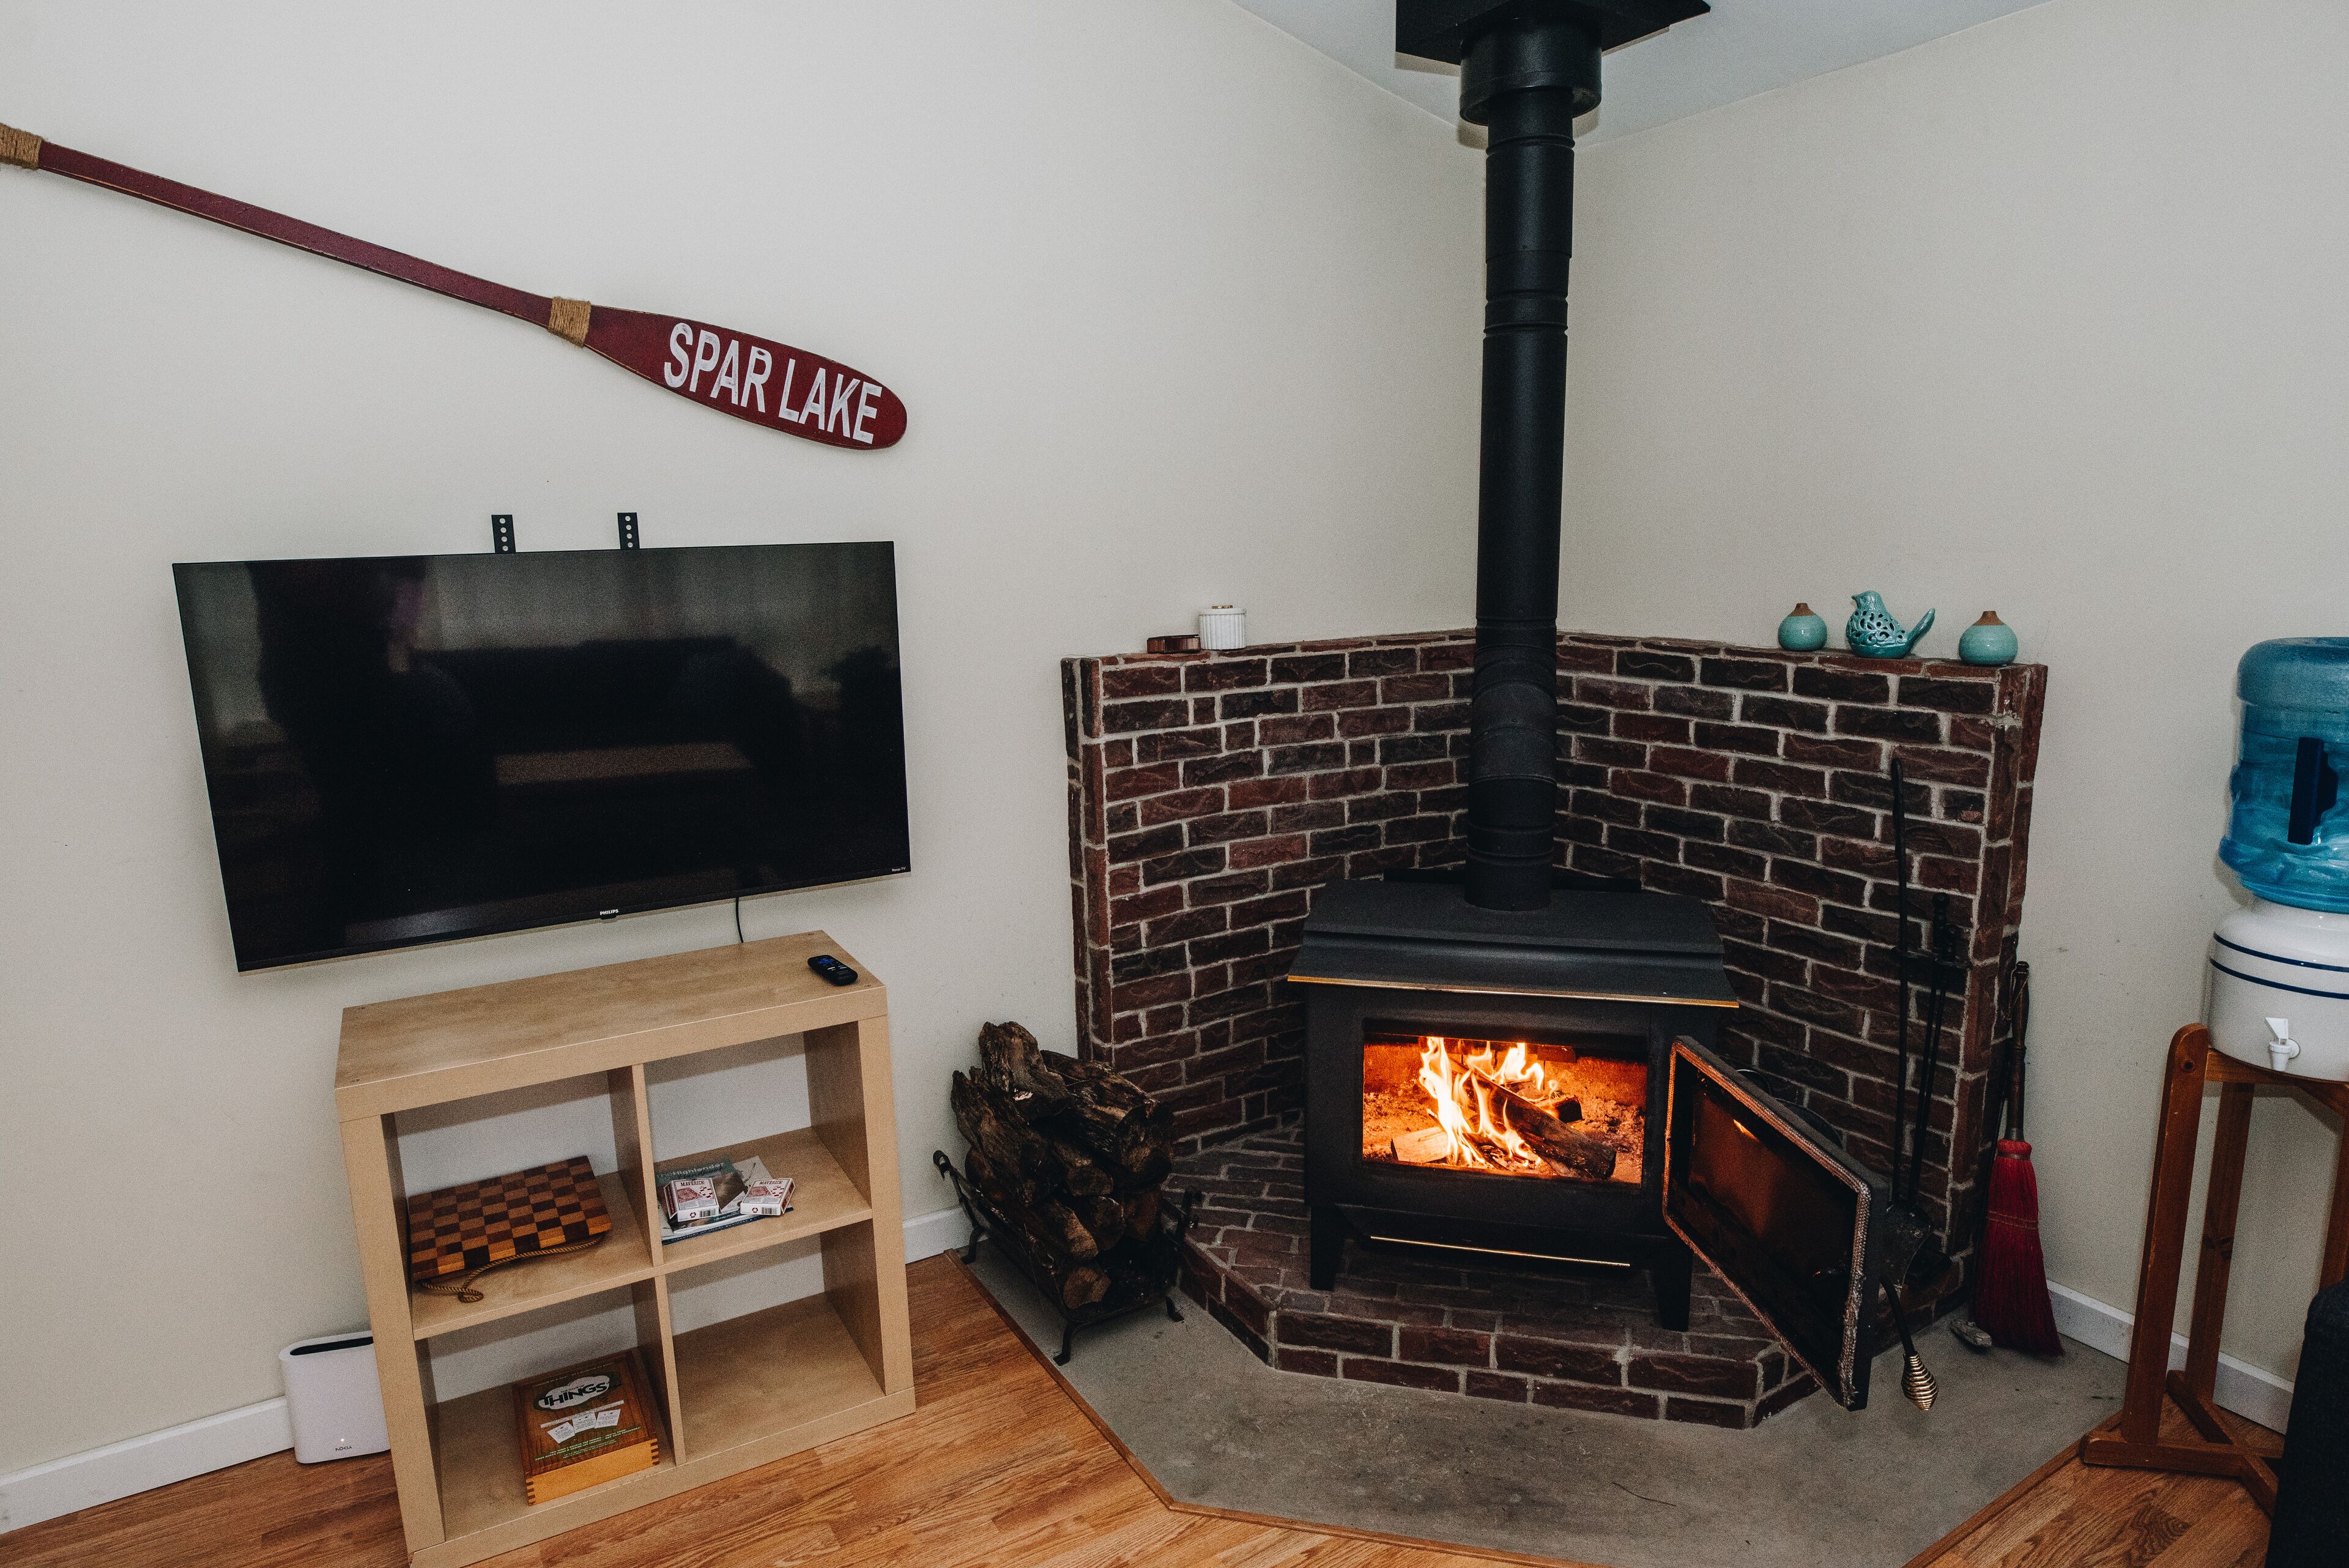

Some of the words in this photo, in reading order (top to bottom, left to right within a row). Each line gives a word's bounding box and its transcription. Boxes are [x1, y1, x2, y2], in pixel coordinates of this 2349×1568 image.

[664, 322, 772, 413] SPAR
[779, 359, 883, 444] LAKE
[673, 1163, 724, 1175] Highlander
[540, 1382, 607, 1406] THINGS
